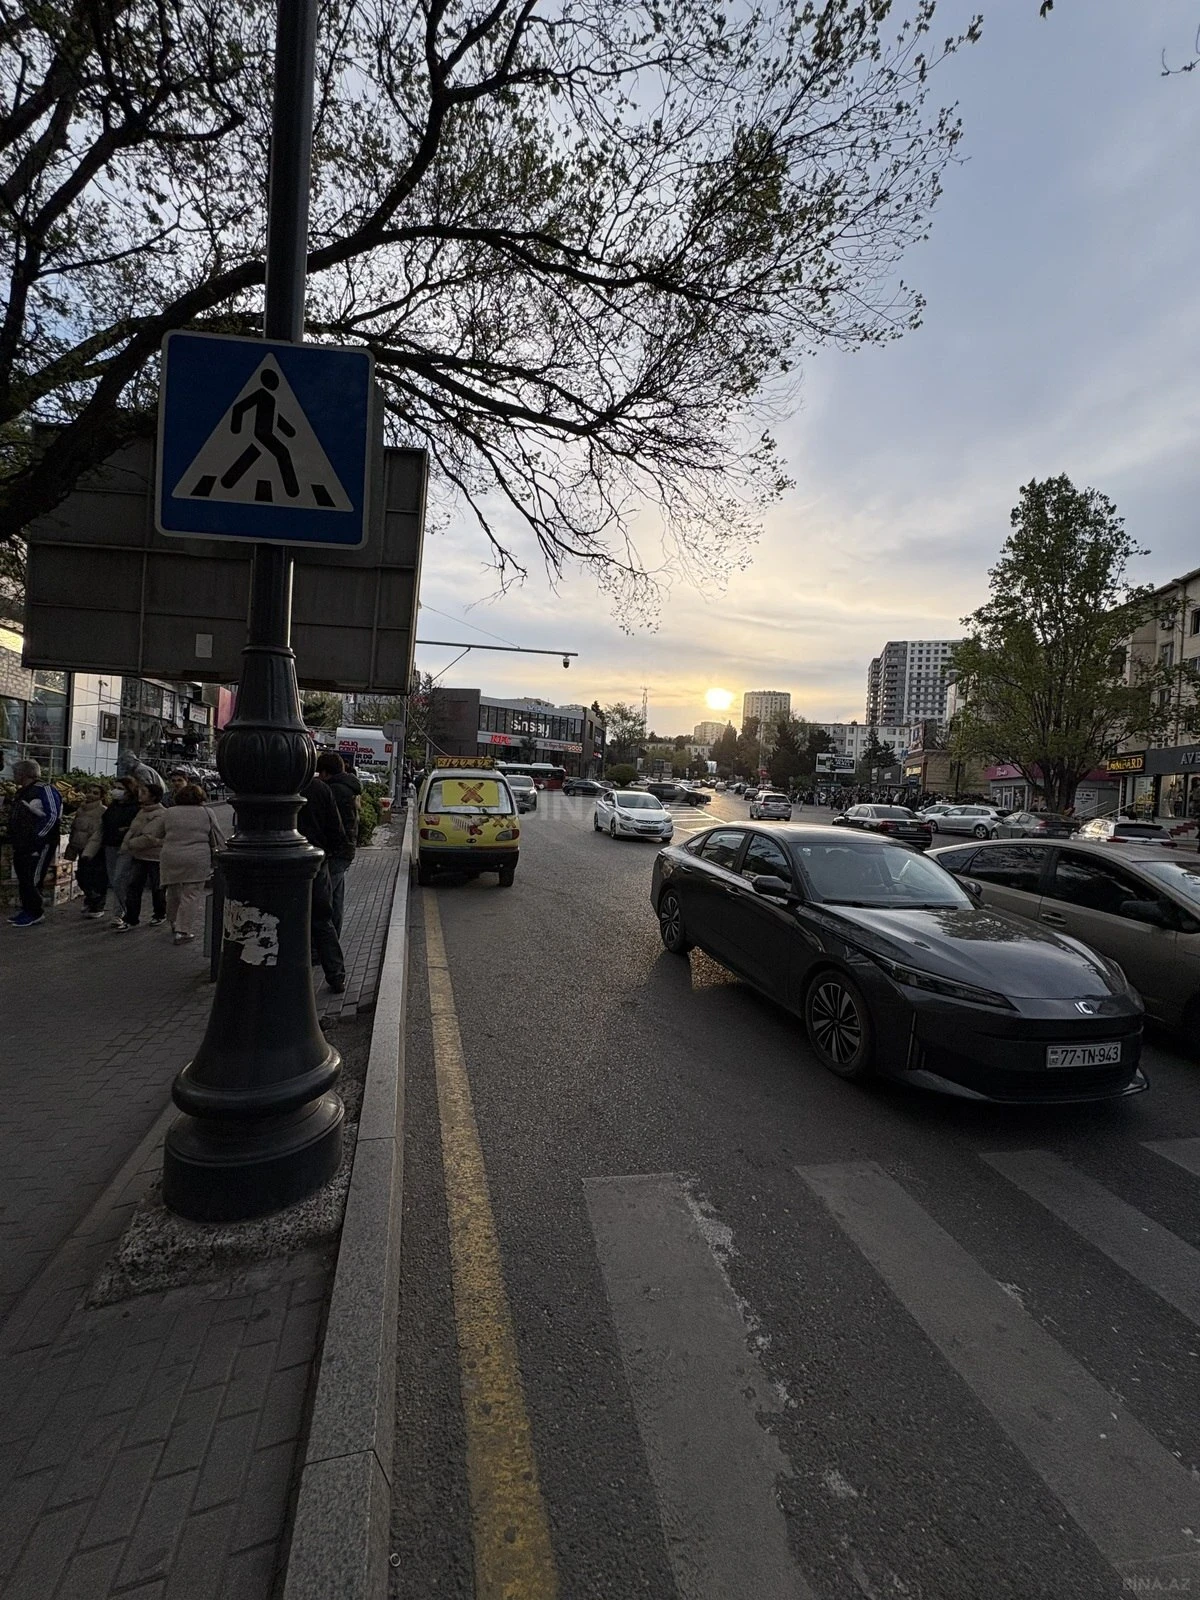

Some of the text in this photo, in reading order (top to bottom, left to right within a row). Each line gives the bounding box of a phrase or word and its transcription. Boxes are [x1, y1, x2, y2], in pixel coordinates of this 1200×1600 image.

[511, 716, 550, 738] sinsay
[491, 735, 512, 745] KFC
[1060, 1046, 1119, 1065] 77-TN-943
